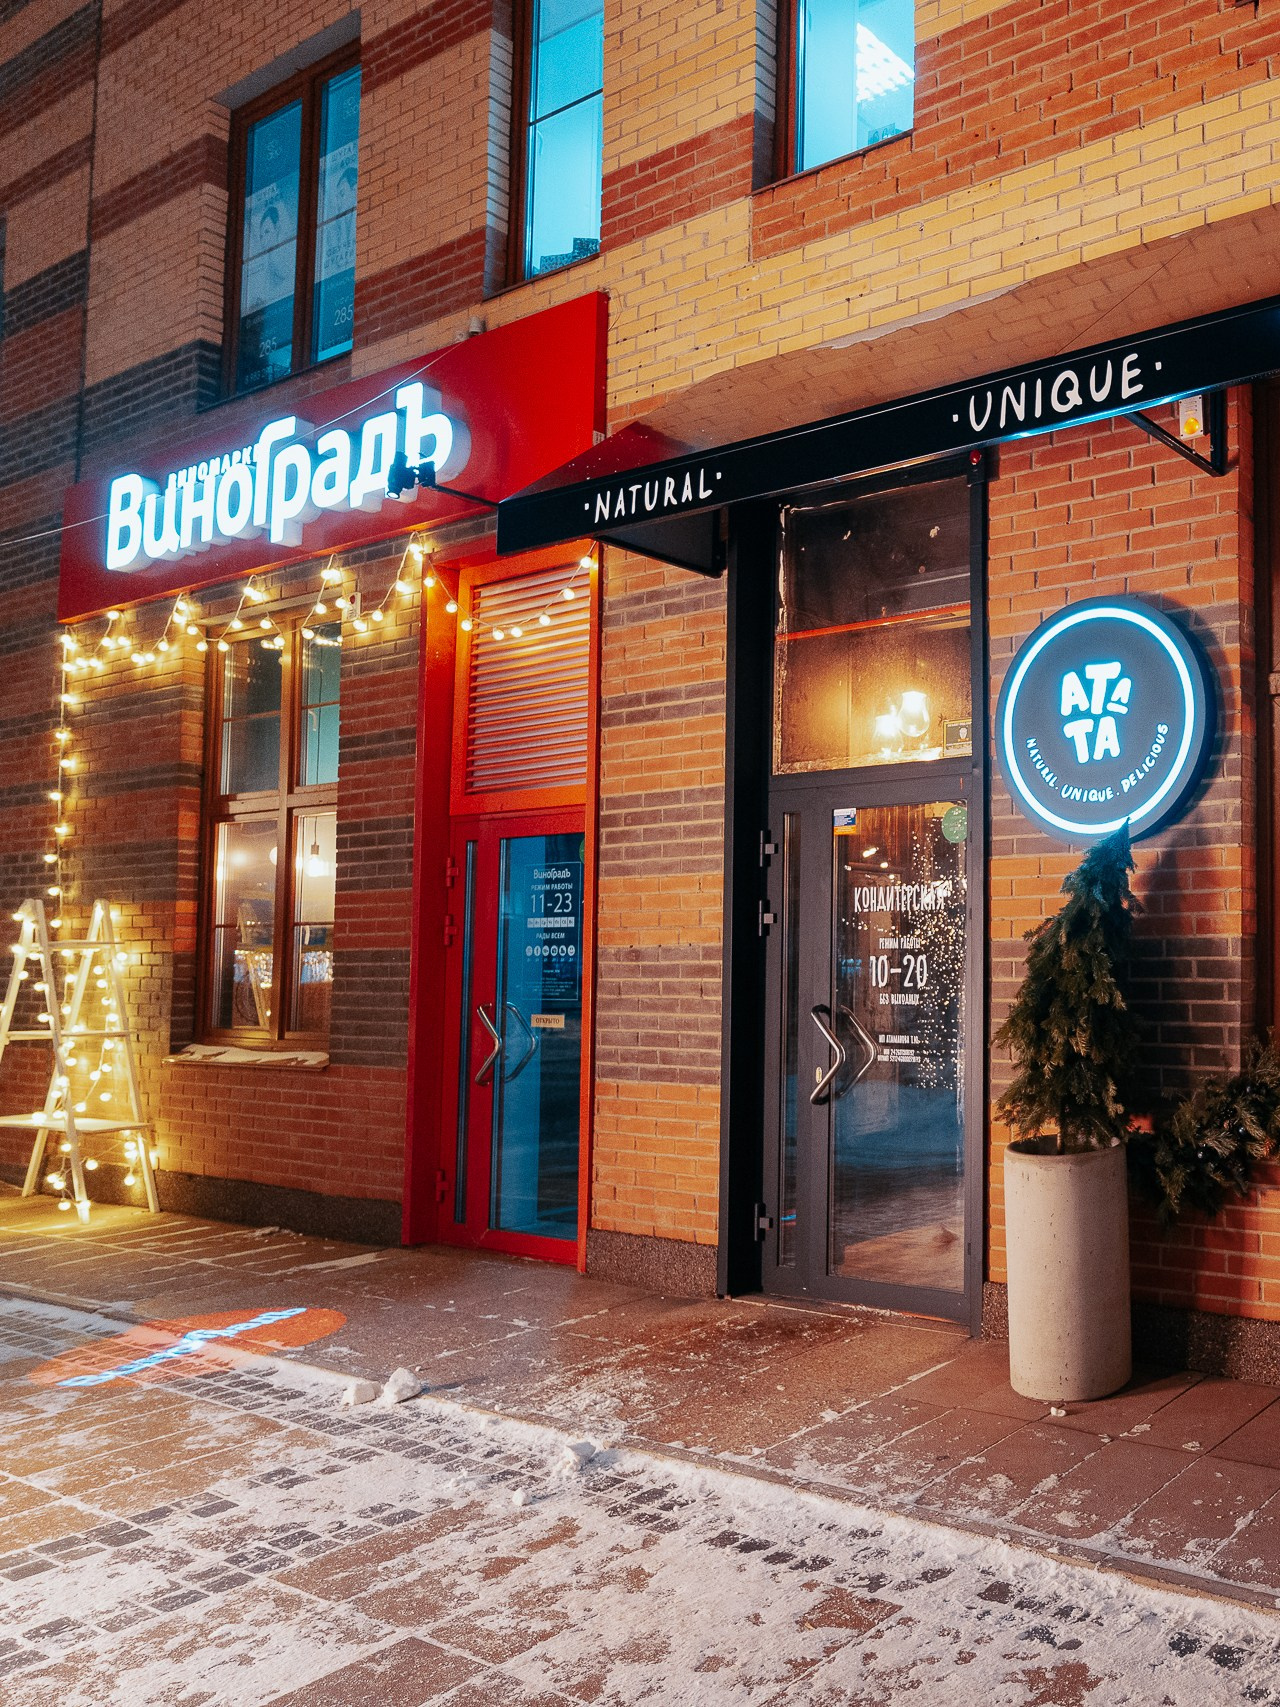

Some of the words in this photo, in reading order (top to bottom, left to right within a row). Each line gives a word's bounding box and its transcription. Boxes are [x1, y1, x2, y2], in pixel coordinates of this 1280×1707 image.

[1063, 716, 1121, 764] TA
[1061, 784, 1114, 802] UNIQUE
[1121, 723, 1169, 793] DELICIOUS
[531, 893, 573, 913] 11-23
[854, 885, 945, 913] КОНДИТЕРСКАЯ
[879, 937, 899, 949] РЕЖИМ
[900, 936, 921, 949] РАБОТЫ
[869, 955, 928, 989] 10-20
[879, 993, 890, 1005] БЕЗ
